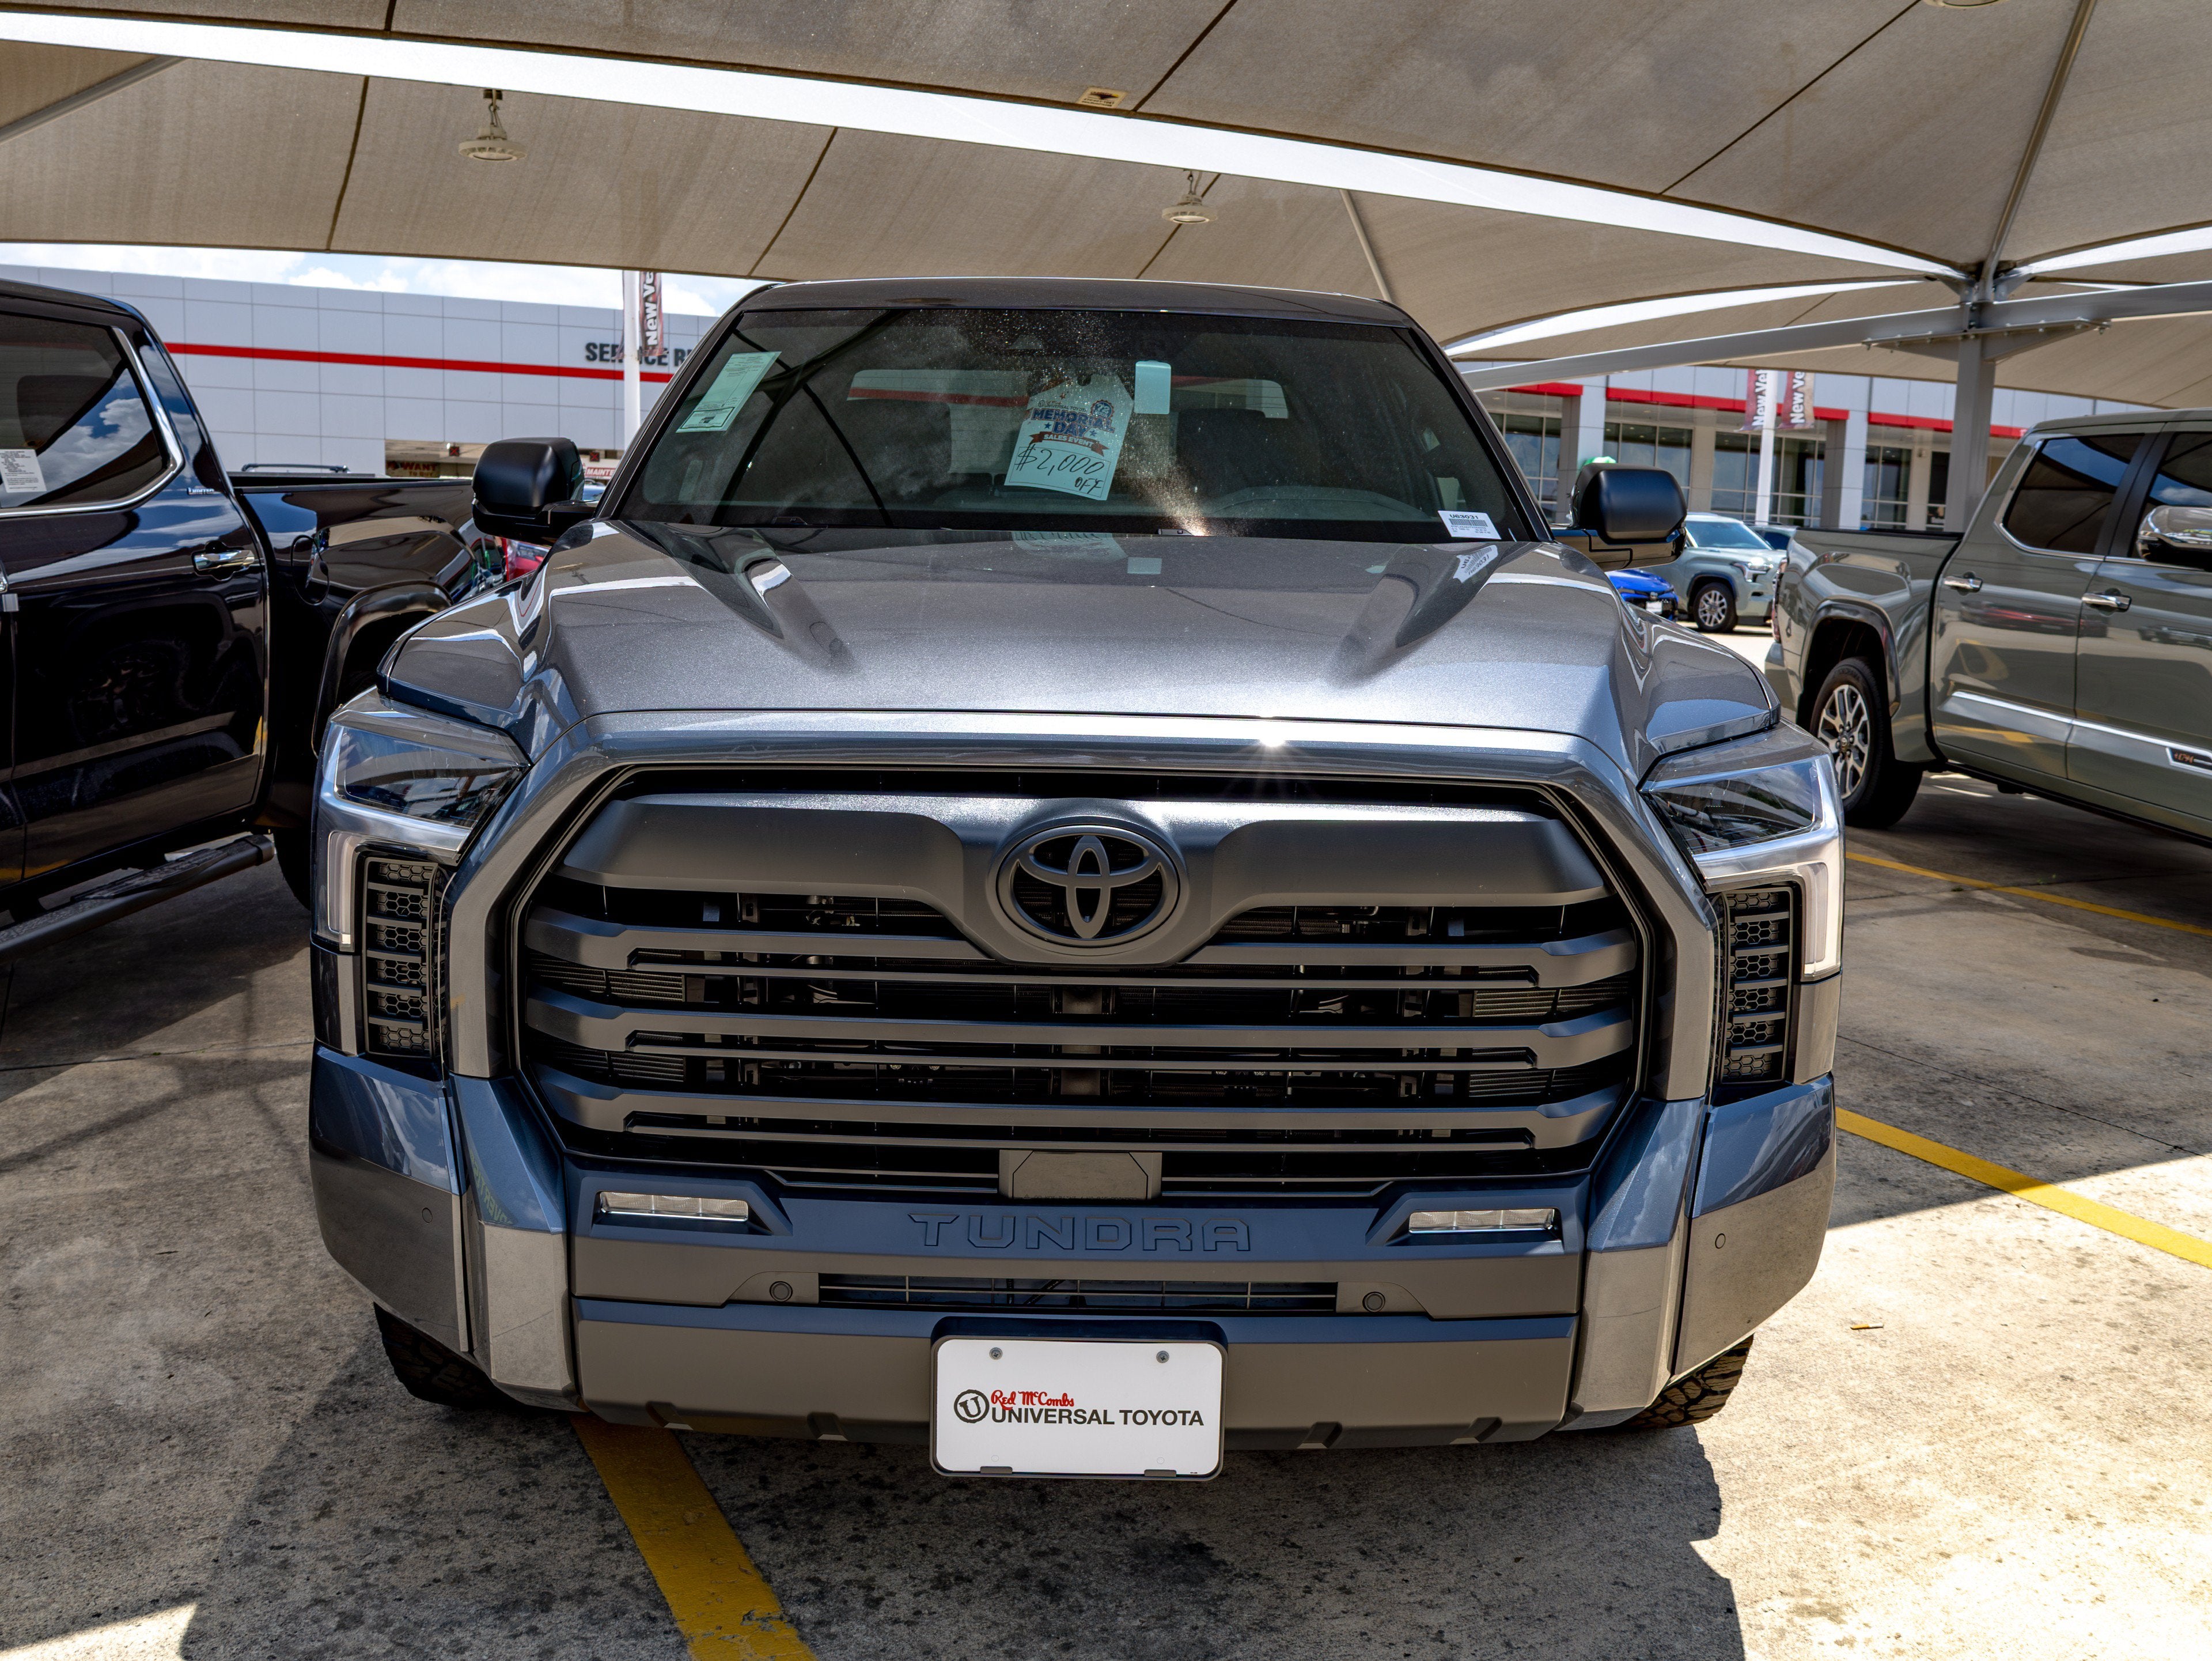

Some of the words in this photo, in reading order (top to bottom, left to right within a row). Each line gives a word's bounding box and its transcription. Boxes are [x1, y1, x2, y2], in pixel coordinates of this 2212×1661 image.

[644, 301, 658, 346] New
[674, 349, 693, 366] R
[1790, 392, 1805, 423] New
[1031, 408, 1116, 433] MEMORIAL
[1052, 421, 1089, 437] DAY
[1068, 437, 1093, 447] EVENT
[402, 462, 438, 471] WANT
[1014, 444, 1104, 476] $2,000
[1074, 477, 1104, 494] OFF
[908, 1213, 1251, 1251] TUNDRA
[991, 1390, 1016, 1410] Red
[1018, 1391, 1074, 1407] McCombs
[991, 1408, 1115, 1425] UNIVERSAL
[1119, 1409, 1204, 1426] TOYOTA
